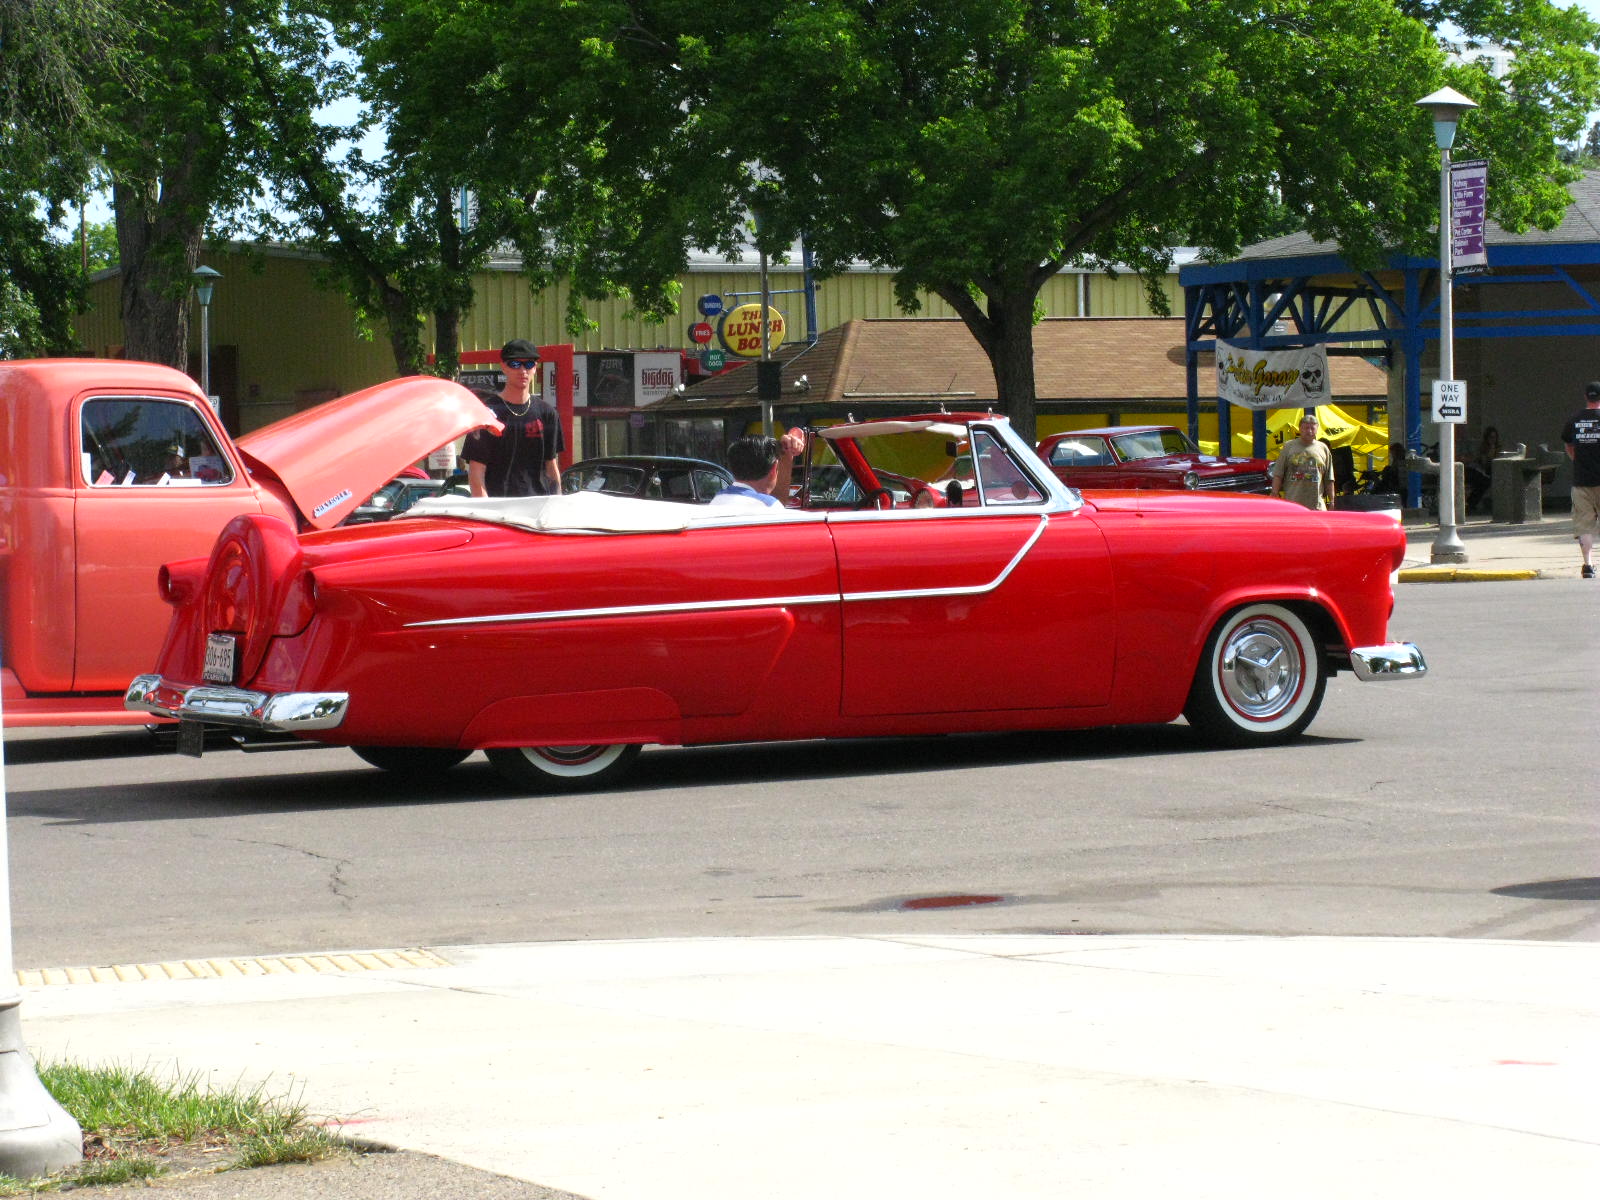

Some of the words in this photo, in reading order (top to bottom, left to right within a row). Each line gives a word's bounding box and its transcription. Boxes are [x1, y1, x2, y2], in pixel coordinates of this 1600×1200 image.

[742, 310, 762, 321] TH
[727, 320, 782, 336] LUNH
[737, 336, 762, 351] BO
[459, 374, 495, 387] FURY
[641, 368, 675, 389] bigdog
[1440, 383, 1459, 392] ONE
[1441, 394, 1459, 403] WAY
